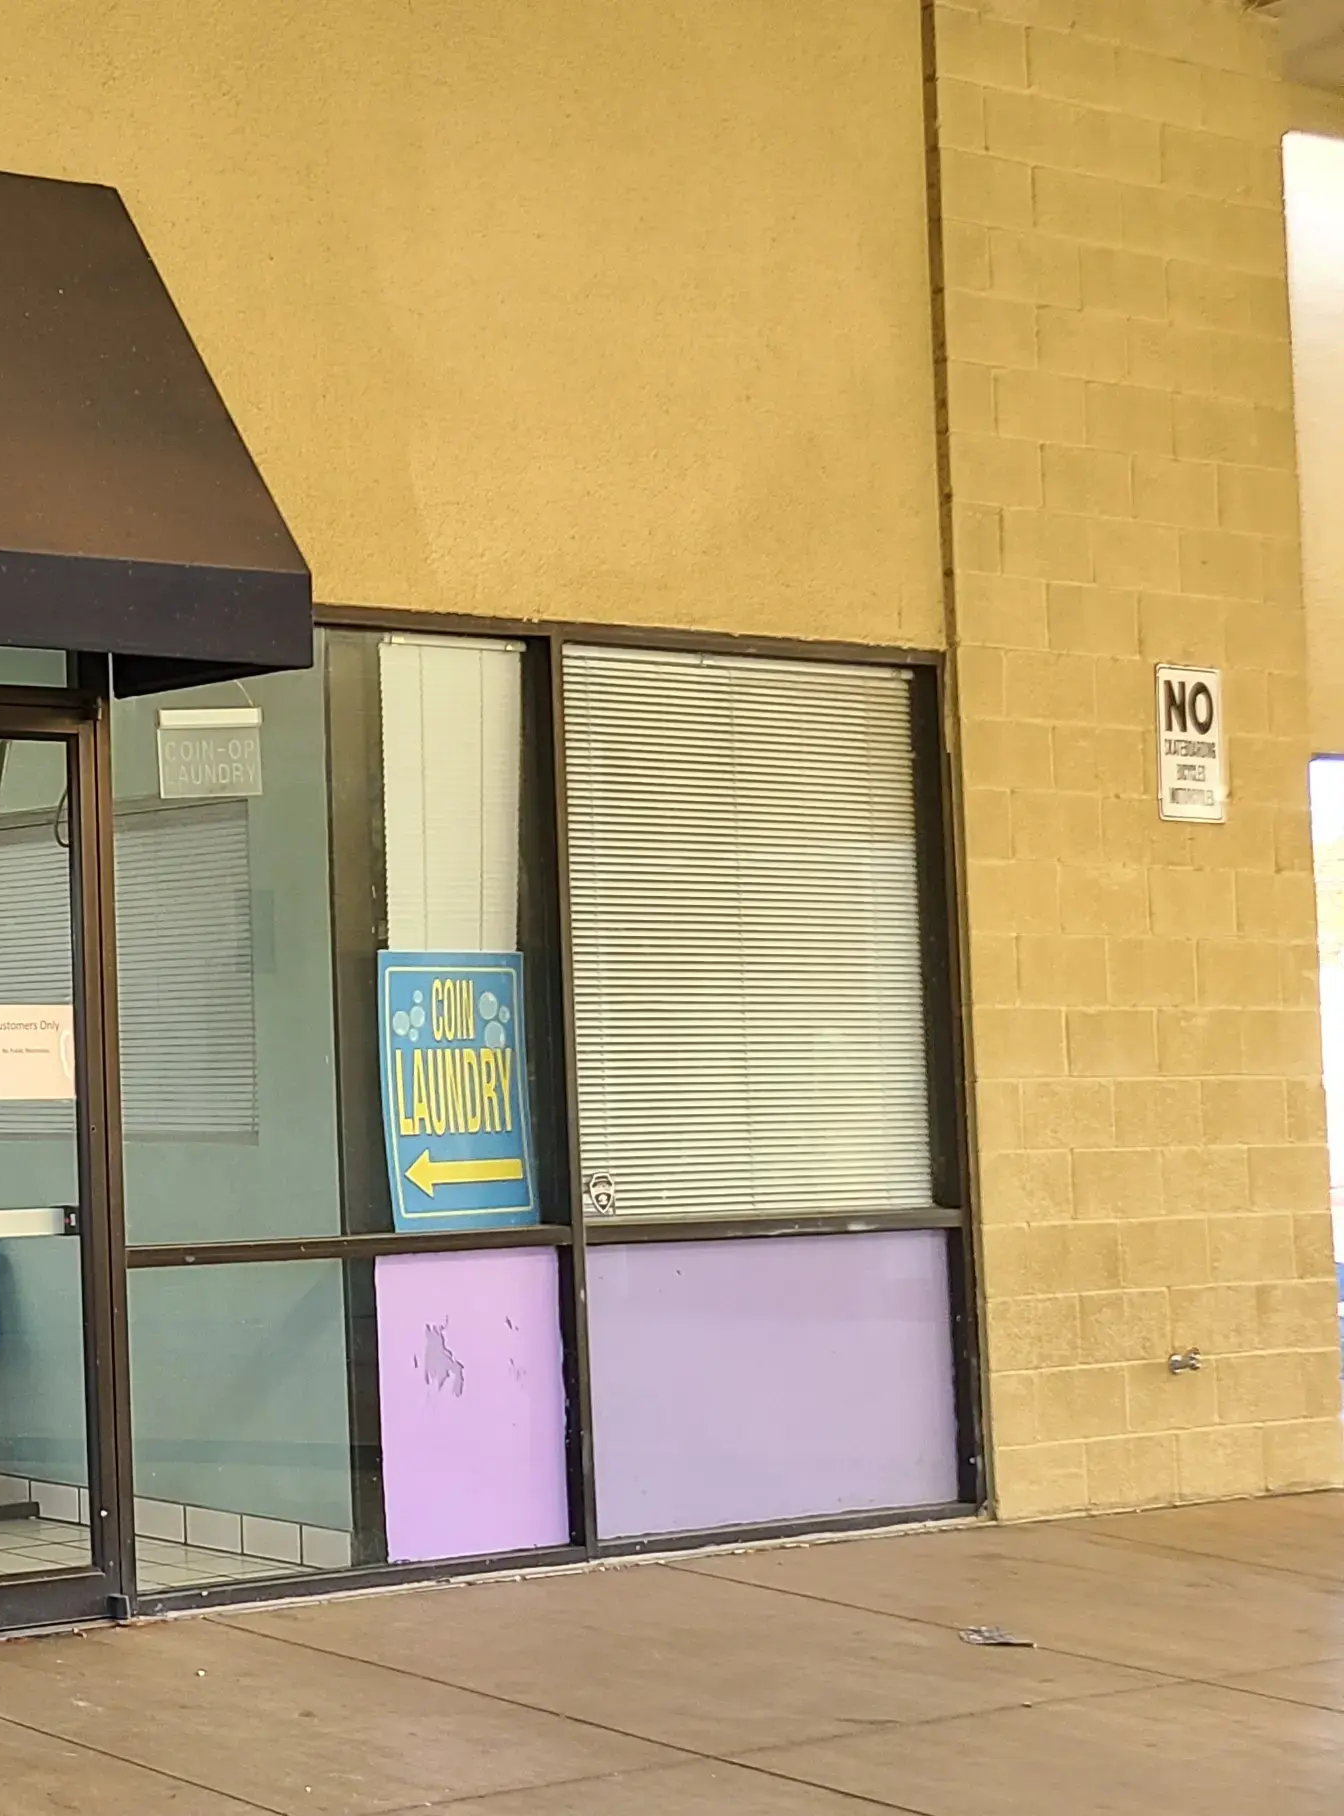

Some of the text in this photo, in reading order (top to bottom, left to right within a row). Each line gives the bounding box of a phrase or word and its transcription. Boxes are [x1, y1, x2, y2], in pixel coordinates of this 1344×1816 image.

[1163, 679, 1214, 735] NO
[164, 738, 255, 762] COIN-OP
[164, 762, 256, 786] LAUNDRY
[40, 1020, 60, 1032] Only
[432, 978, 475, 1041] COIN
[395, 1047, 513, 1136] LAUNDRY
